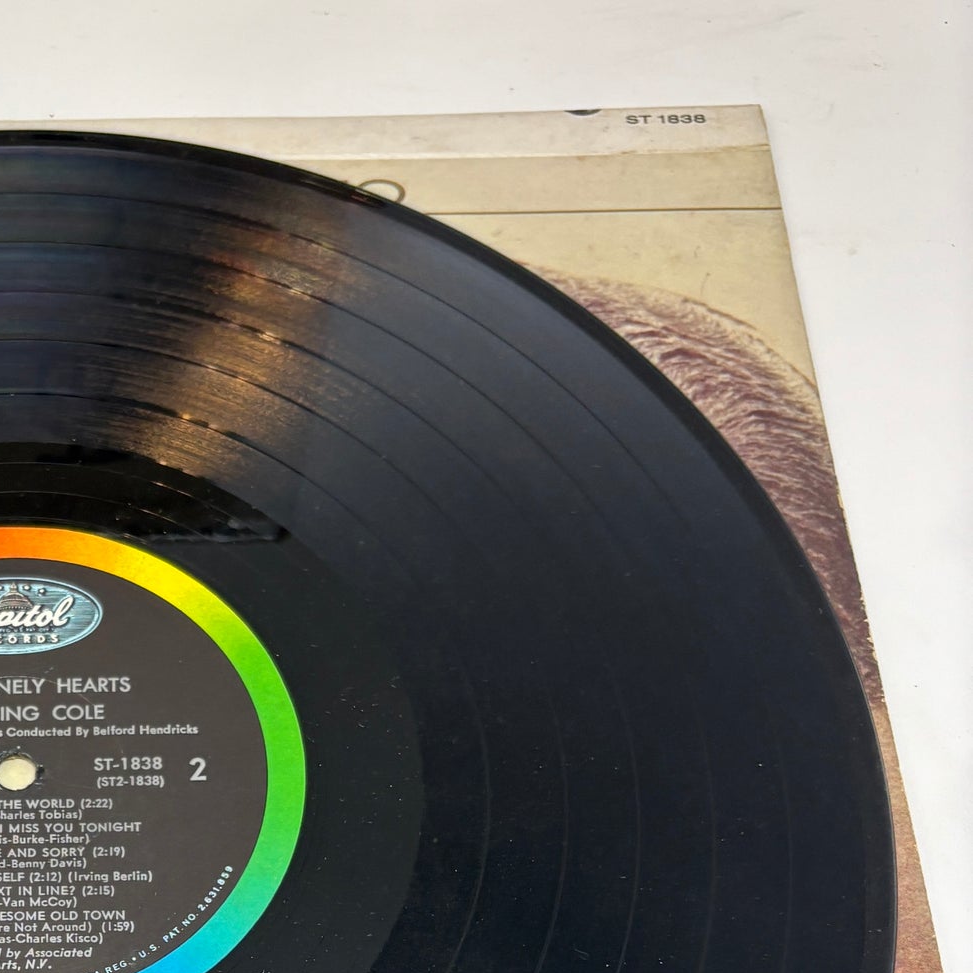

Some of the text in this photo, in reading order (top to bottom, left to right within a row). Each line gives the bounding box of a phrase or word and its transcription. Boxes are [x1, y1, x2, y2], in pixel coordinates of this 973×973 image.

[625, 114, 706, 124] ST 1838
[57, 677, 131, 694] HEARTS
[52, 704, 105, 720] COLE
[6, 726, 71, 738] Conducted
[76, 726, 89, 738] By
[93, 725, 135, 736] Belford
[139, 724, 199, 735] Hendricks
[93, 757, 163, 771] ST-1838
[189, 757, 207, 781] 2
[96, 776, 165, 789] (ST2-1838)
[26, 799, 75, 808] WORLD
[80, 798, 113, 810] (2:22)
[39, 809, 83, 820] Tobias)
[8, 823, 39, 833] MISS
[44, 823, 73, 833] YOU
[79, 822, 142, 832] TONIGHT
[7, 848, 36, 858] AND
[42, 847, 85, 857] SORRY
[92, 846, 125, 858] (2:19)
[50, 858, 87, 869] Davis)
[30, 872, 62, 883] (2:12)
[68, 872, 108, 883] (Irving
[113, 870, 152, 882] Berlin)
[18, 886, 32, 896] IN
[38, 886, 76, 896] LINE?
[82, 885, 114, 897] (2:15)
[30, 896, 77, 908] McCoy)
[50, 910, 78, 921] OLD
[83, 910, 126, 920] TOWN
[14, 922, 38, 932] Not
[42, 922, 92, 934] Around)
[102, 921, 134, 933] (1:59)
[66, 932, 103, 944] Kisco)
[6, 948, 21, 960] by
[25, 947, 92, 958] Associated
[26, 959, 52, 970] N.V.
